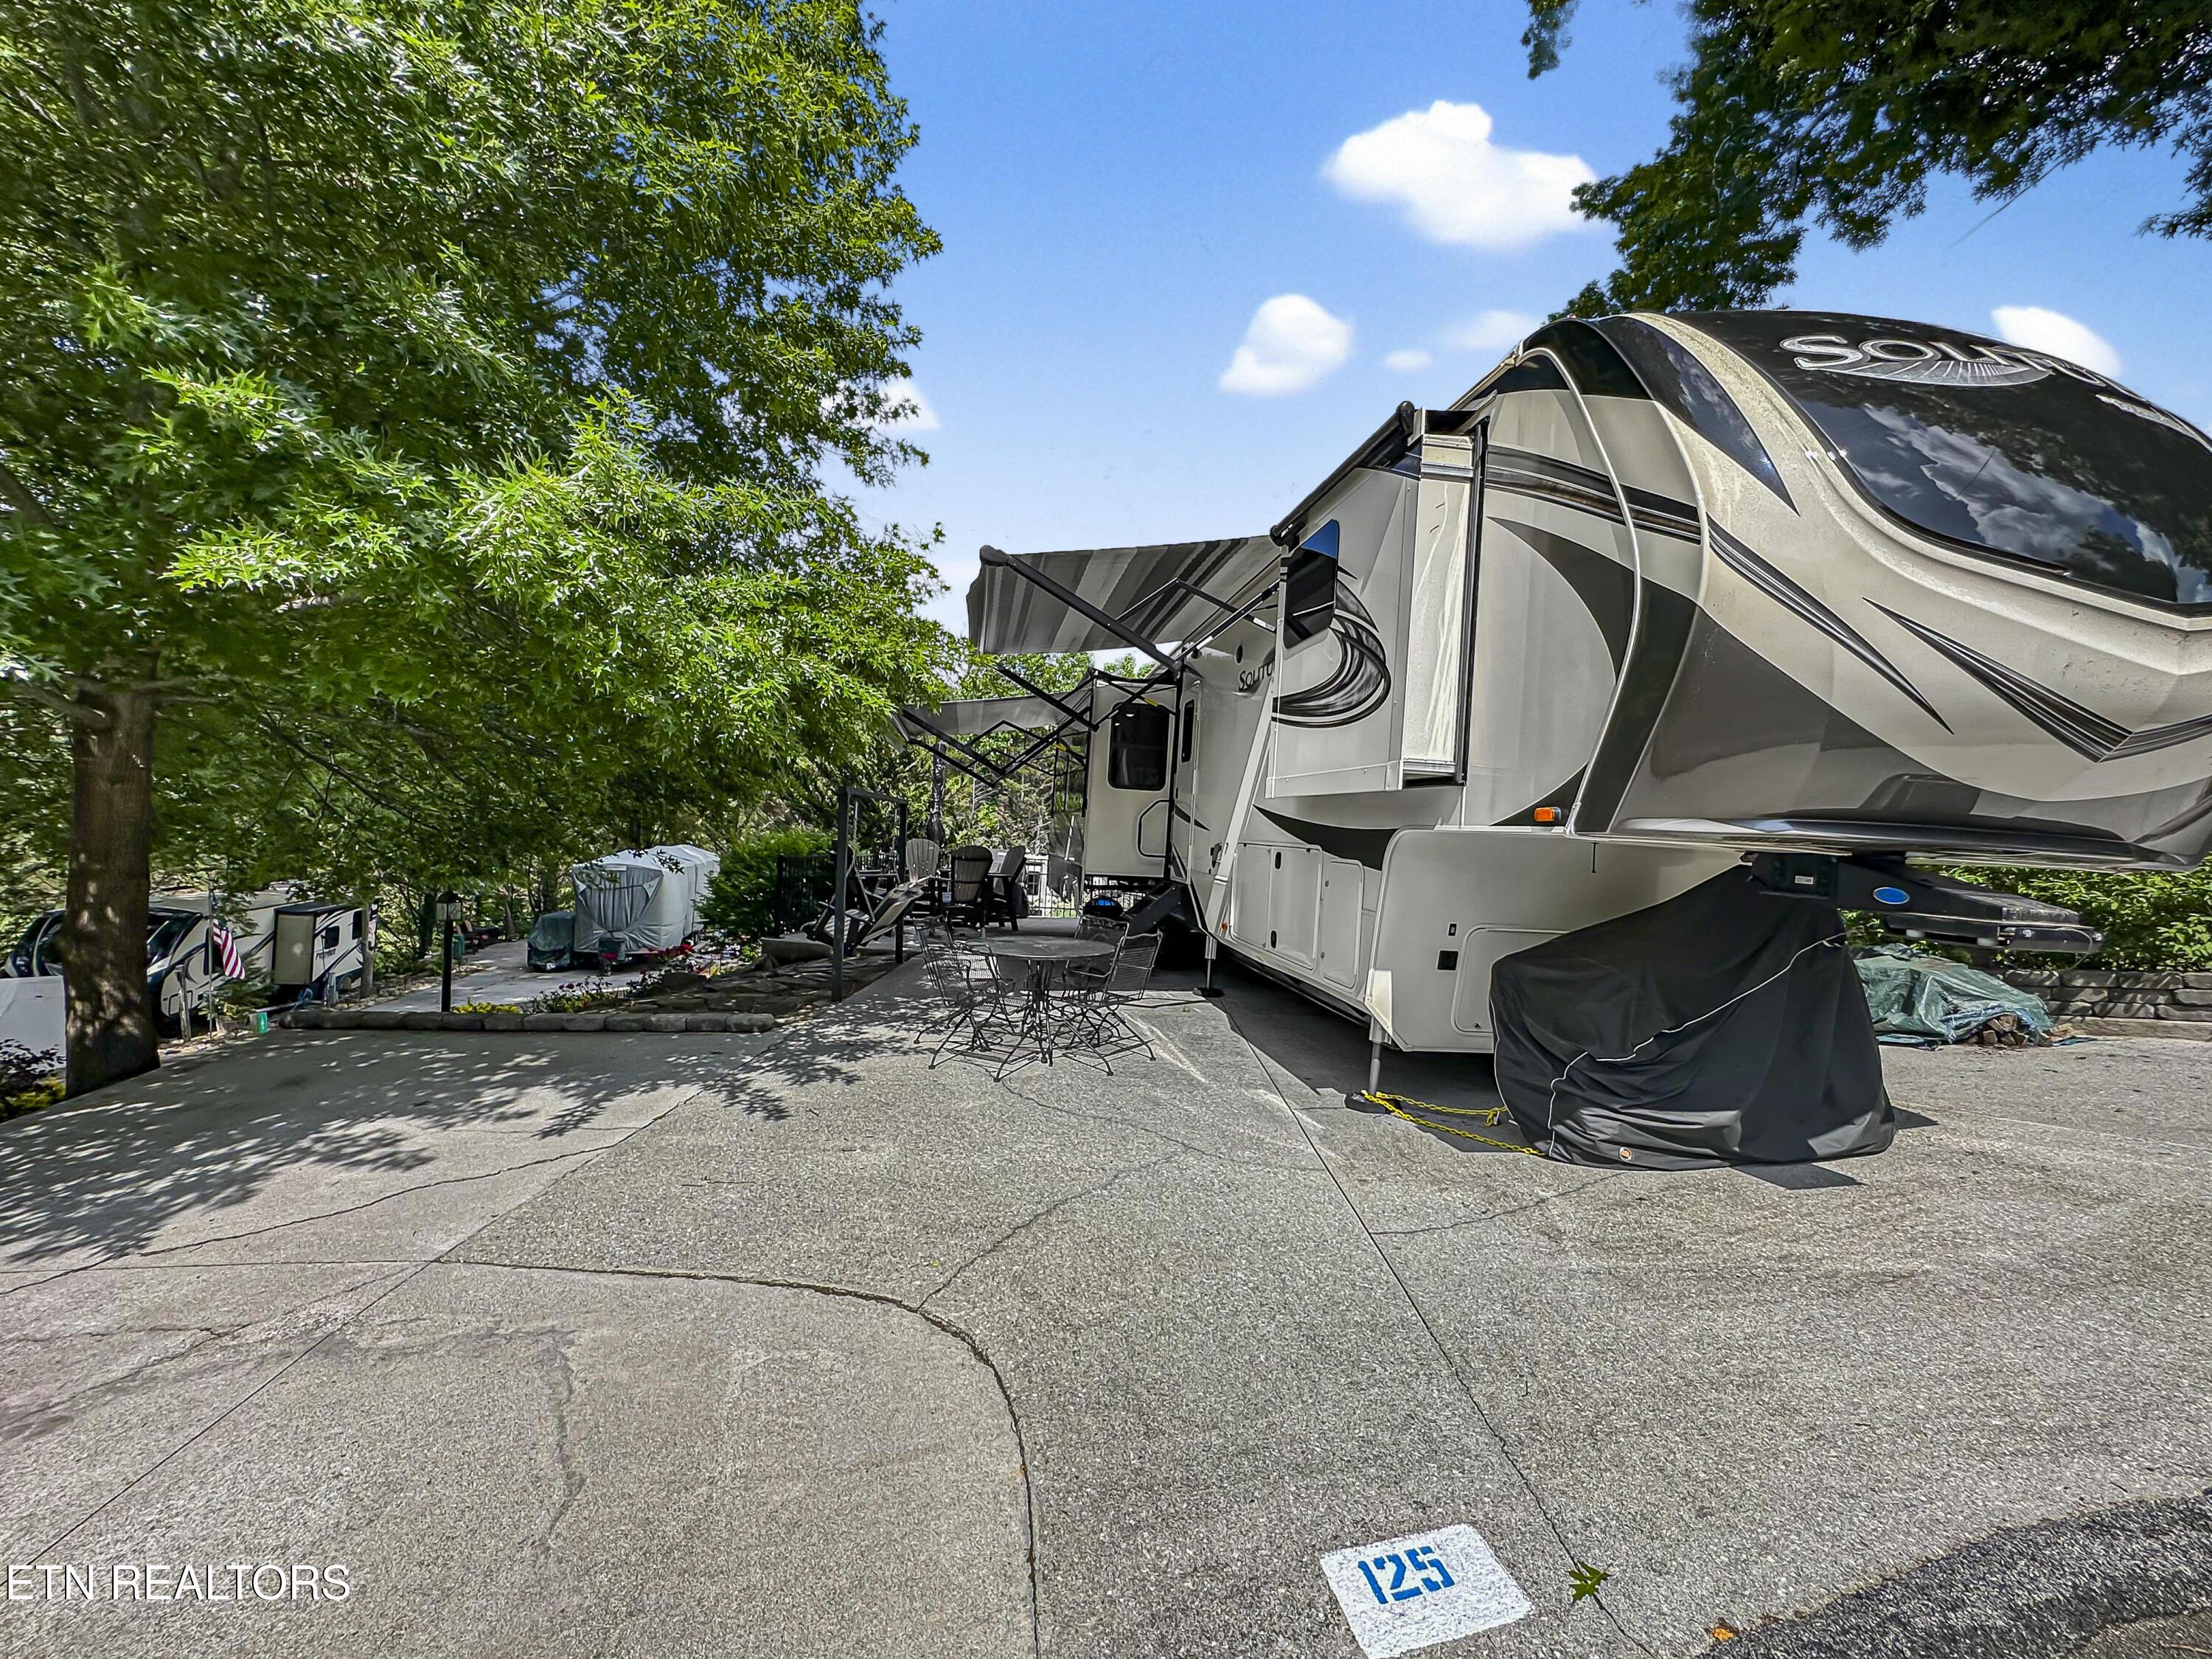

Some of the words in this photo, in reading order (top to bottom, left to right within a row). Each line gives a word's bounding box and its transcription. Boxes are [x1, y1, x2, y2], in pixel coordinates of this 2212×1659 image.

[1779, 335, 2147, 401] SOLITU
[1239, 661, 1276, 692] SOLITU
[1357, 1545, 1455, 1604] 125
